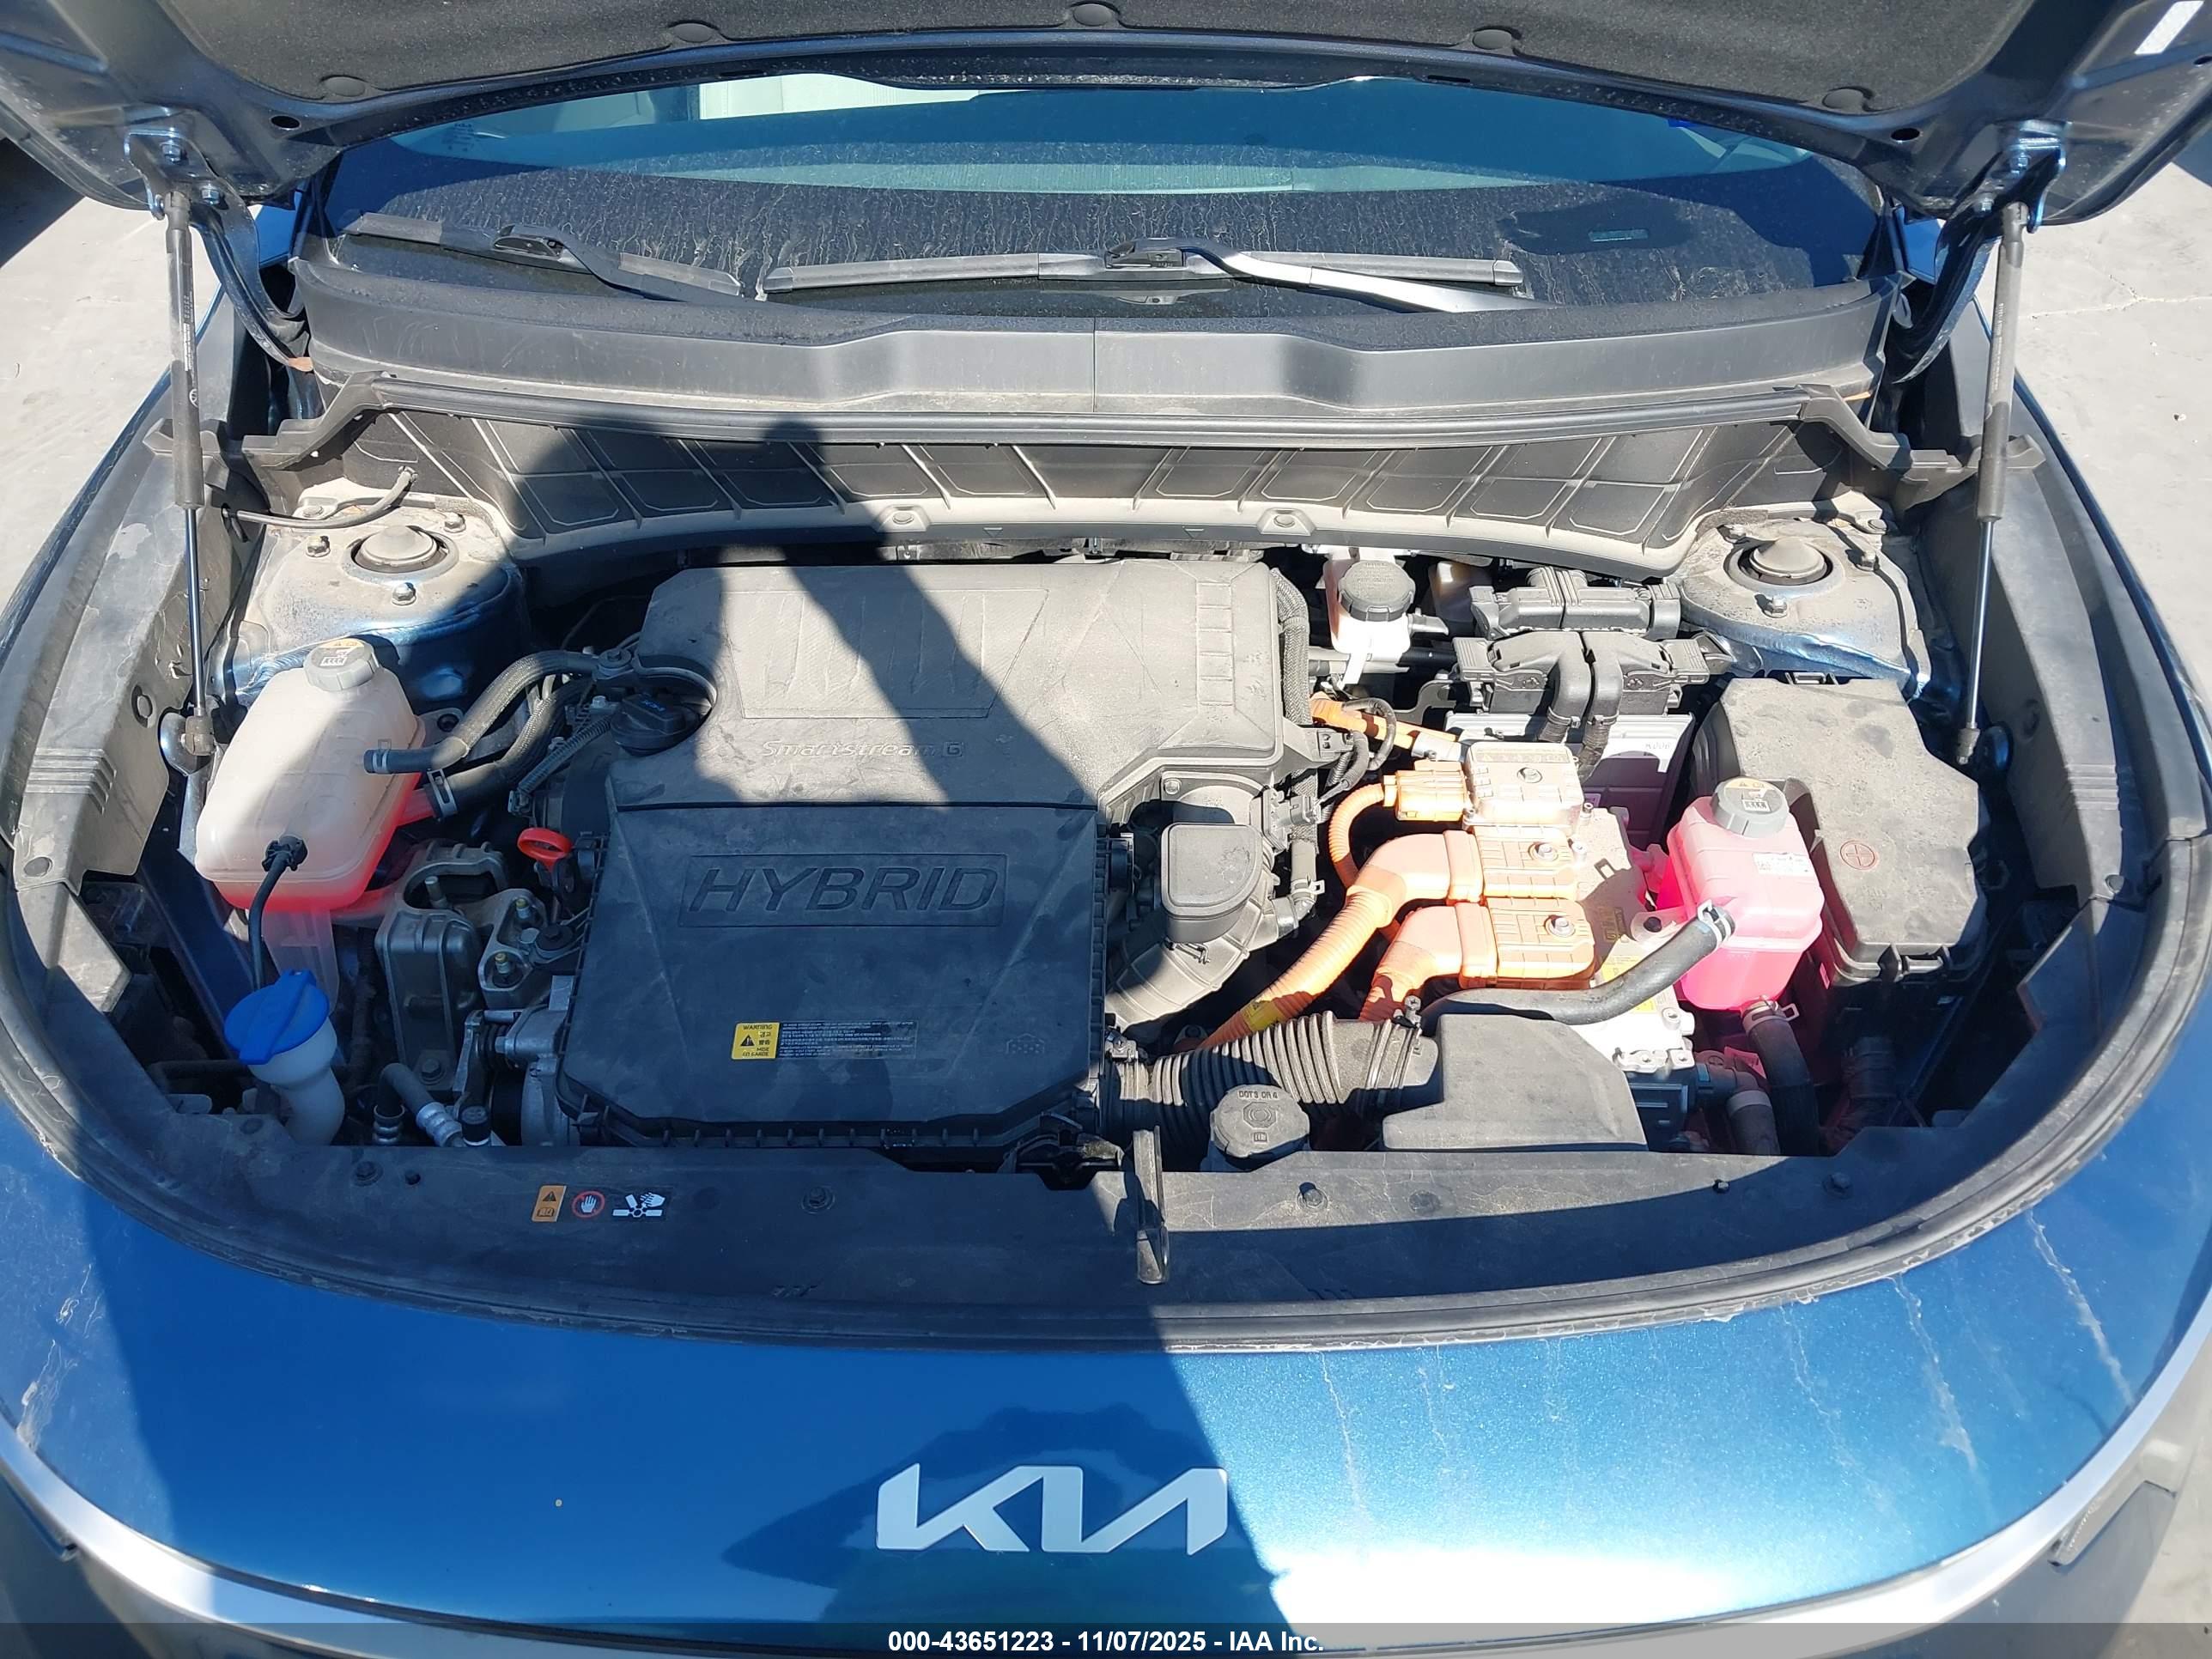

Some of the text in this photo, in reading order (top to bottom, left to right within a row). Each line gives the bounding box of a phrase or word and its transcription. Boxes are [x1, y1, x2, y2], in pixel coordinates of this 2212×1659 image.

[762, 739, 937, 757] Smartstream
[688, 867, 1000, 912] HYBRID
[876, 1462, 1229, 1555] KIA
